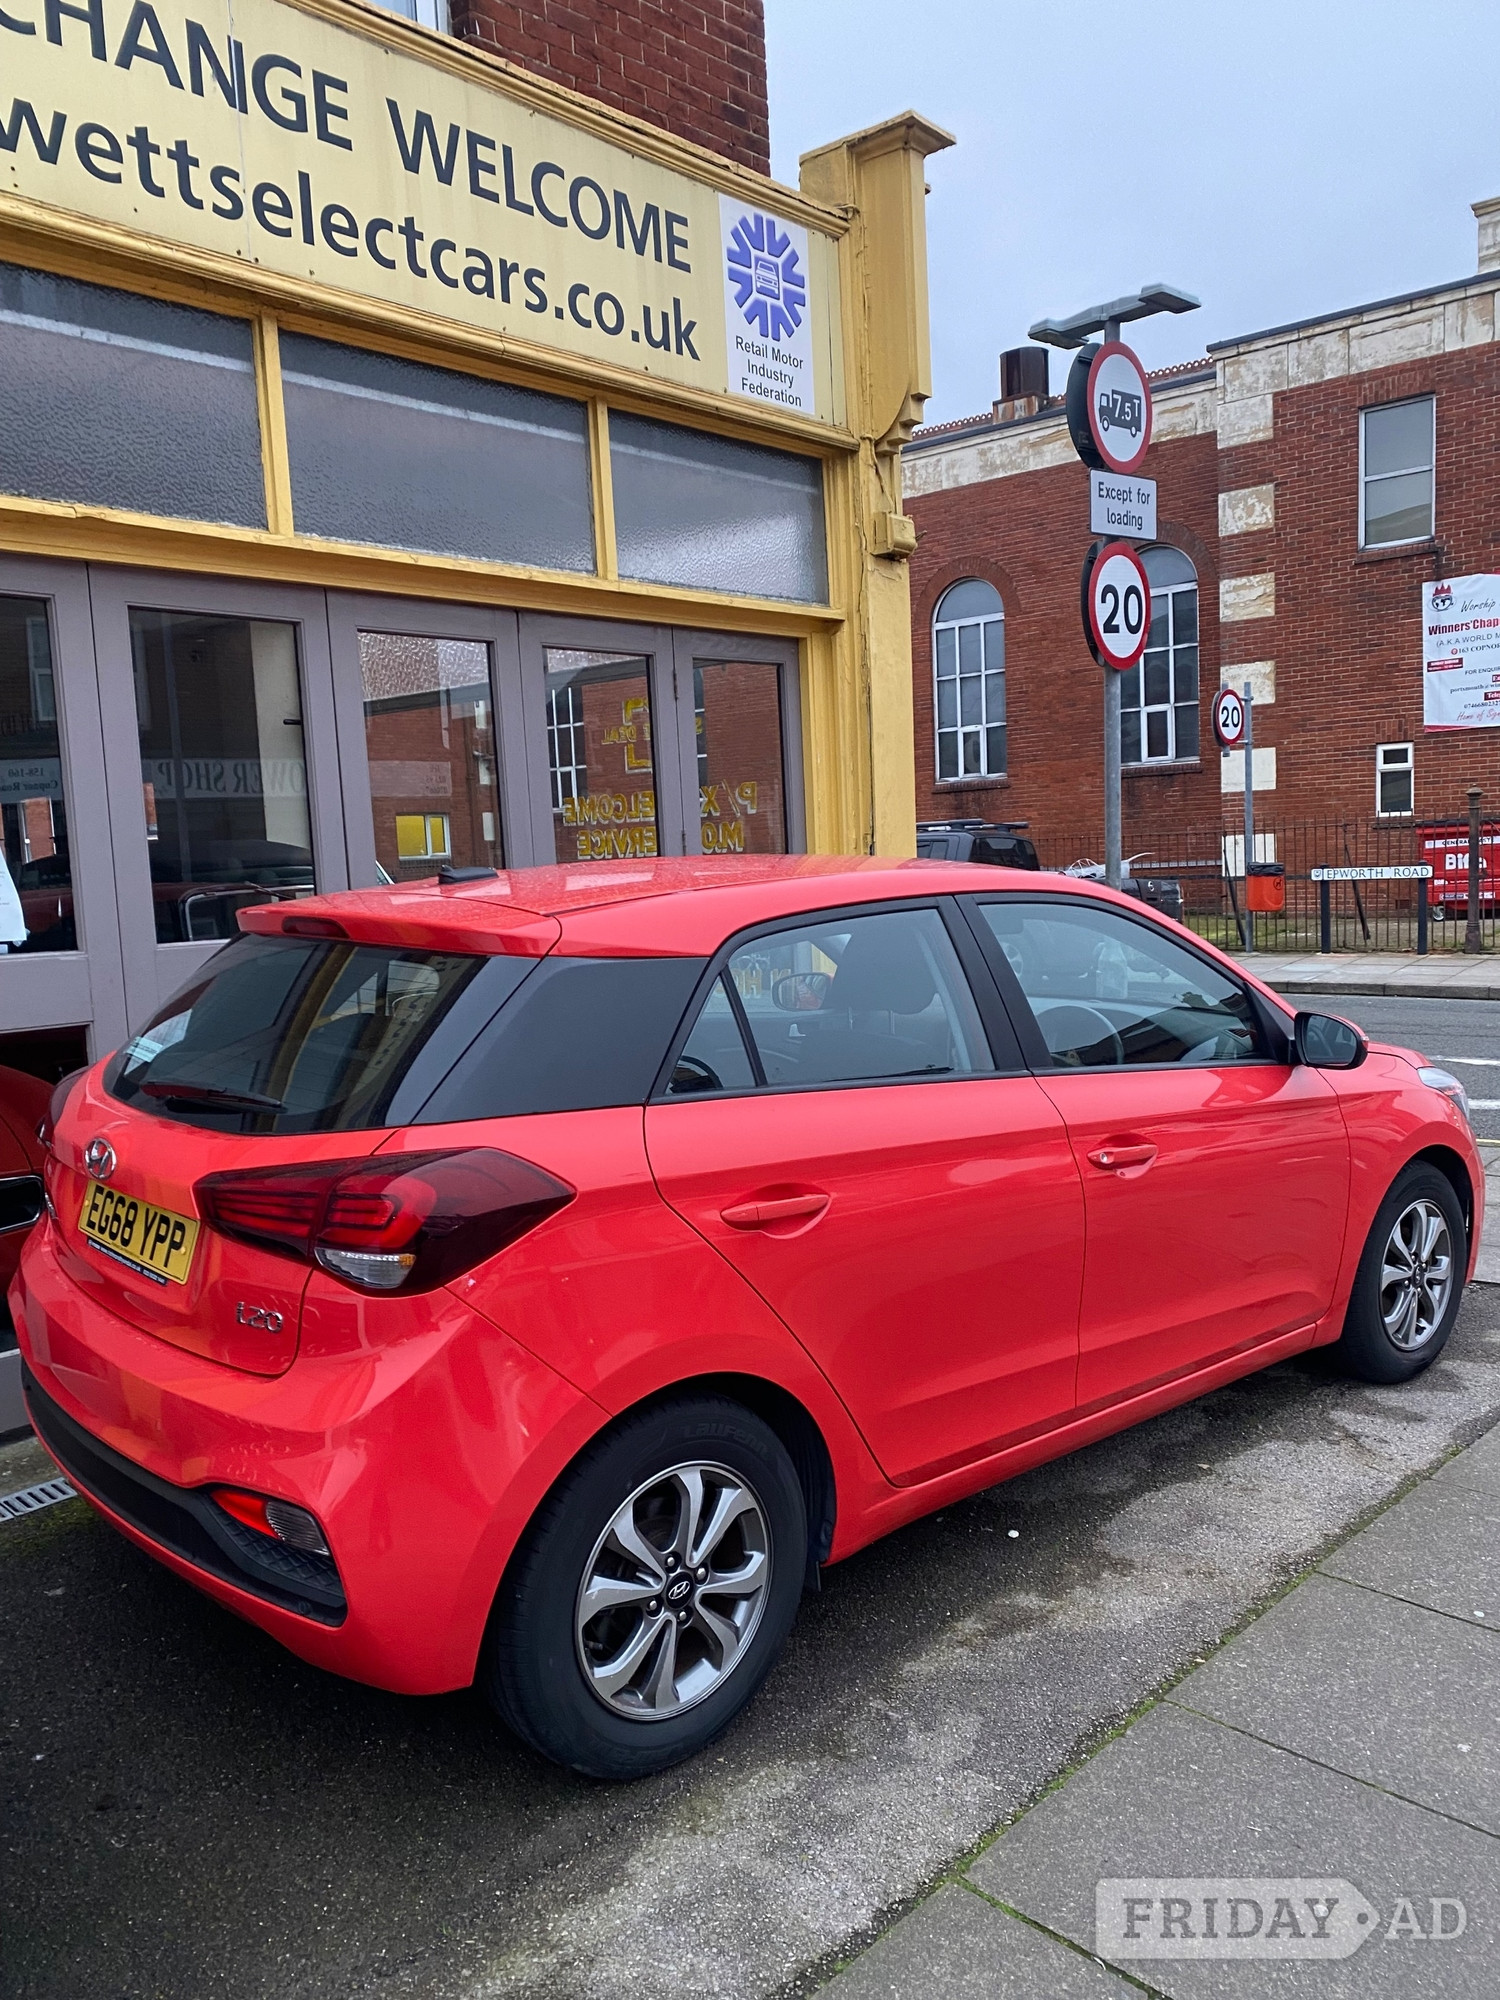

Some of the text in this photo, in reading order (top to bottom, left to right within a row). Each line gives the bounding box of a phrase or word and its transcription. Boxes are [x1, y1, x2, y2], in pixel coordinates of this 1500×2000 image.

[385, 96, 692, 274] WELCOME
[735, 335, 804, 369] Retail Motor
[747, 358, 794, 389] Industry
[741, 376, 802, 407] Federation
[1098, 481, 1151, 505] Except for
[1106, 507, 1143, 530] loading
[1100, 583, 1143, 635] 20
[1460, 598, 1496, 613] Worship
[1462, 633, 1493, 643] WORLD
[1221, 706, 1241, 728] 20
[1326, 867, 1429, 879] EPWORTH ROAD
[86, 1184, 138, 1248] EG68
[139, 1204, 186, 1268] YPP
